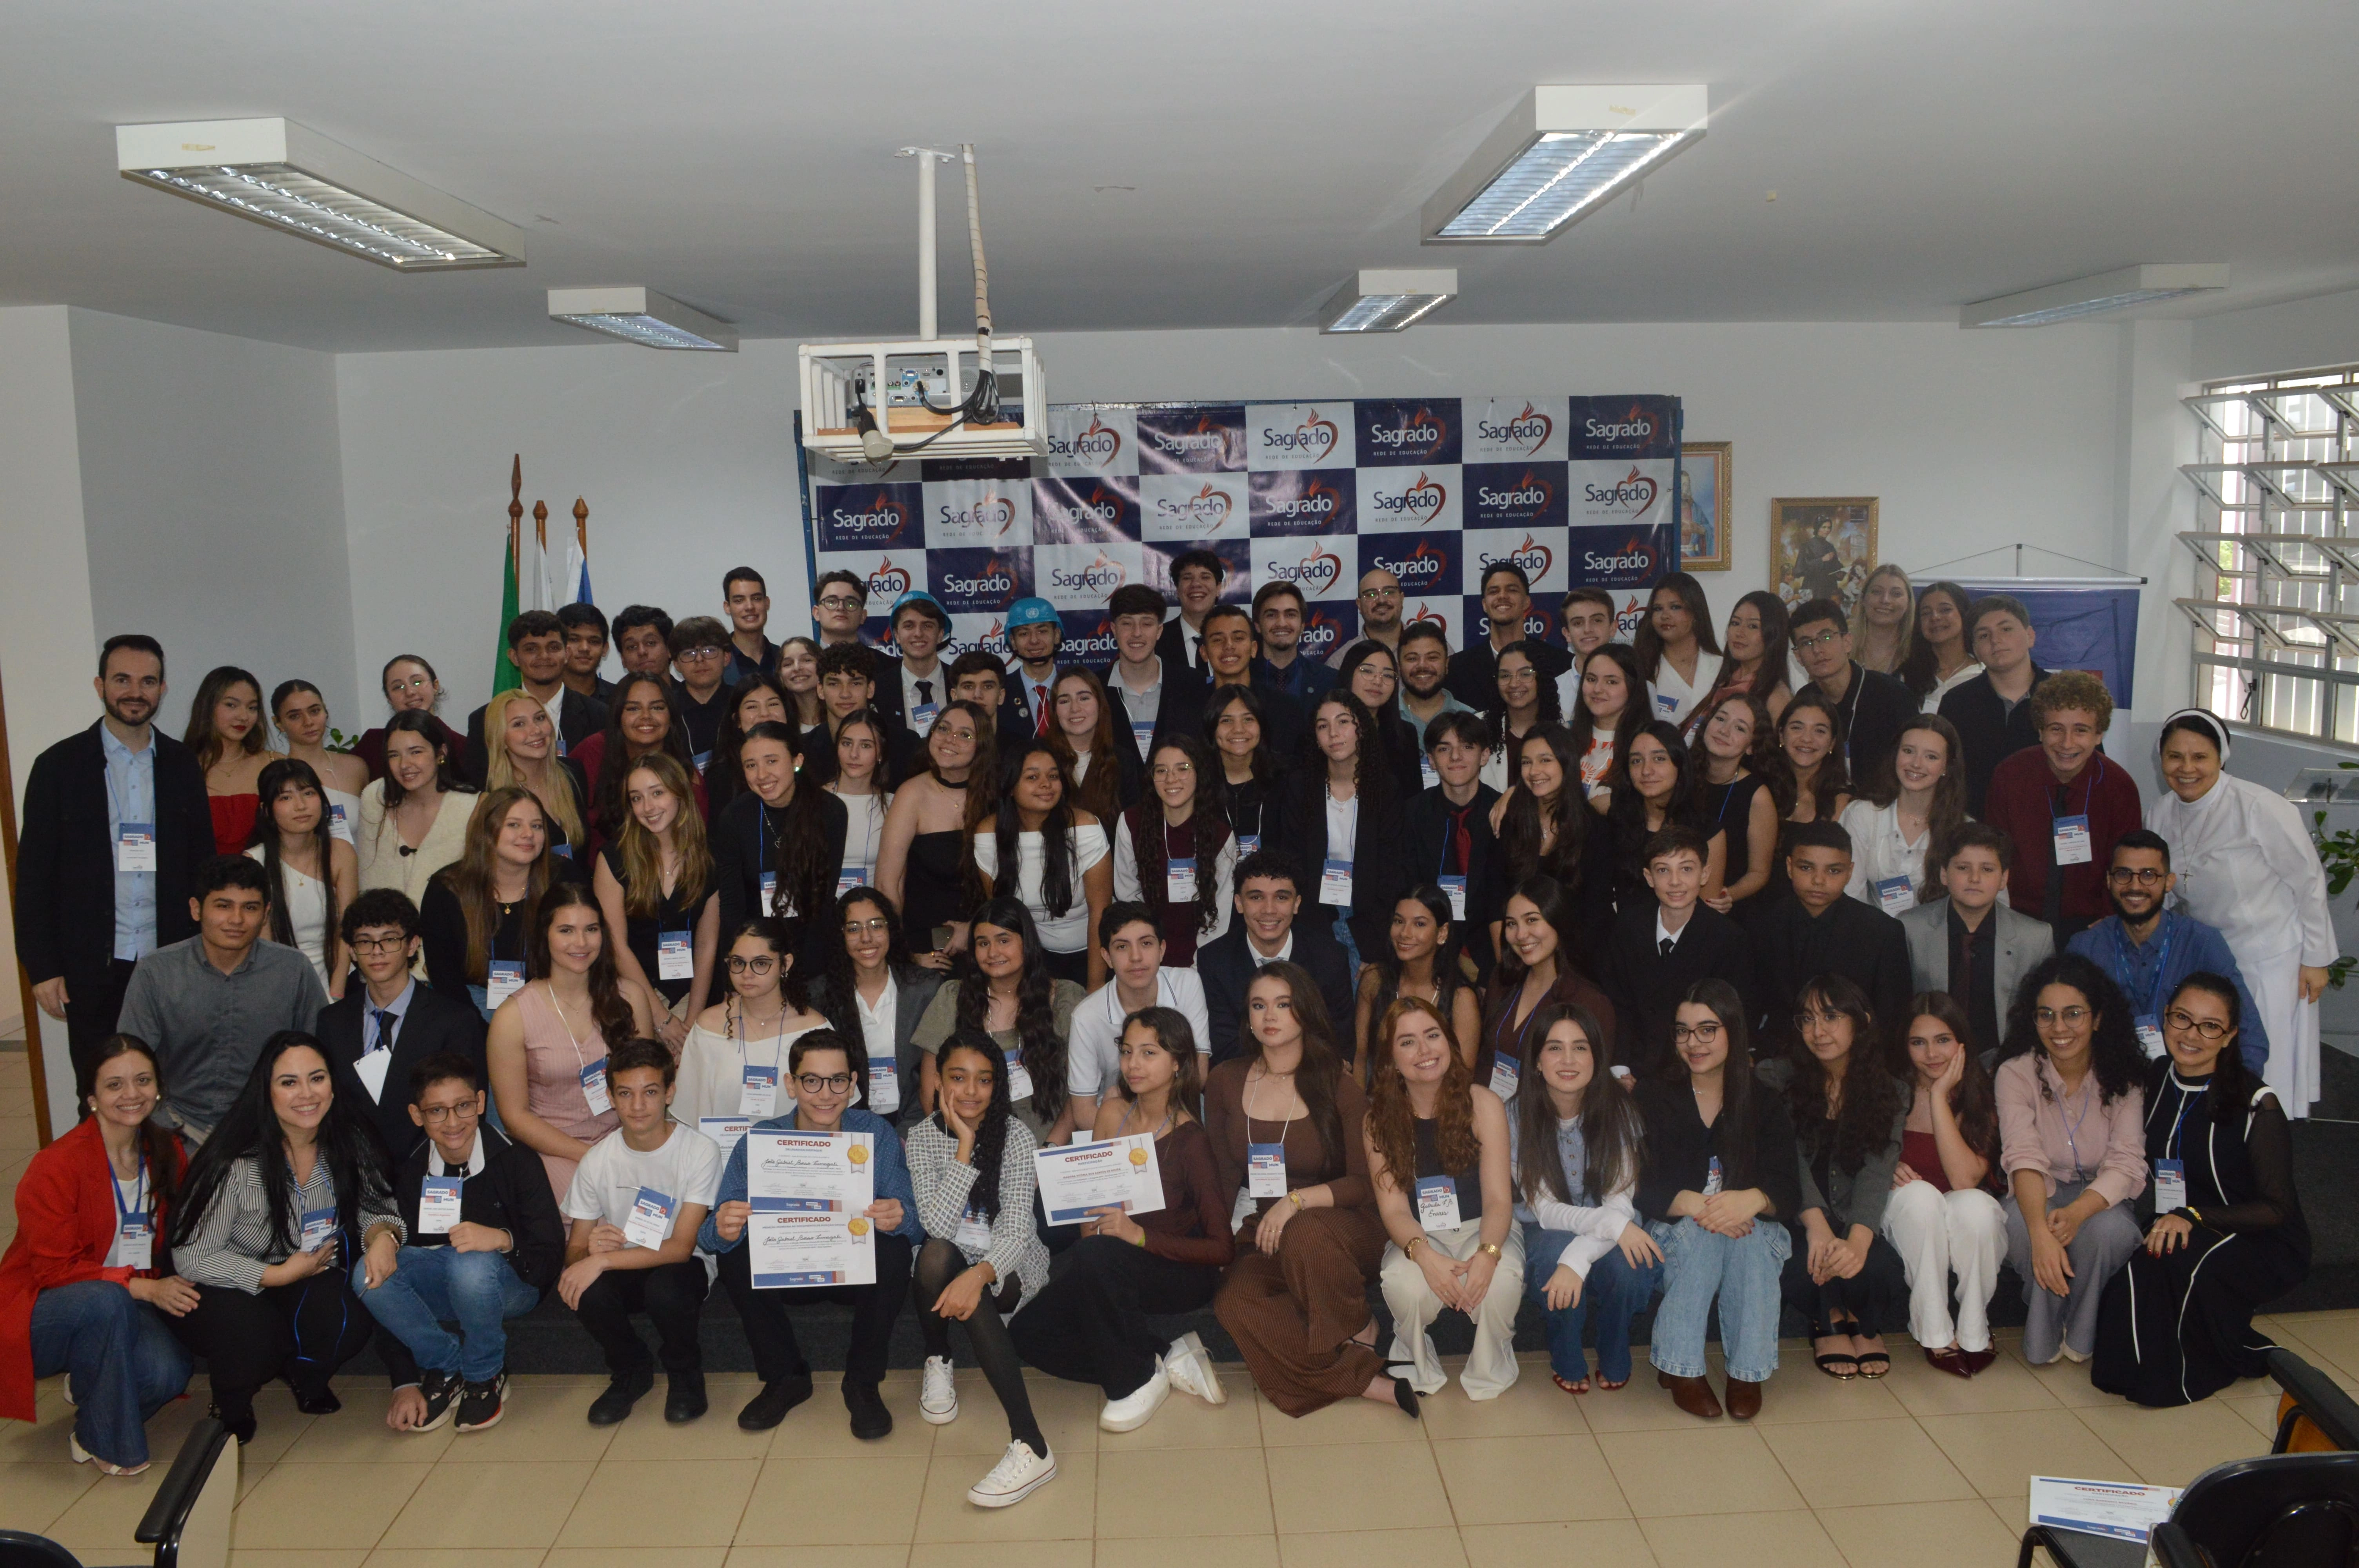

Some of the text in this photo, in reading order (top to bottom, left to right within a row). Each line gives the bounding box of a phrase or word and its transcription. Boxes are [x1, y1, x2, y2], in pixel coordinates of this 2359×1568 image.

[1264, 428, 1330, 450] Sagrado
[1372, 424, 1437, 447] Sagrado
[1479, 421, 1544, 443] Sagrado
[1586, 419, 1650, 441] Sagrado
[1048, 435, 1112, 457] Sagrado
[1155, 432, 1220, 454] Sagrado
[1374, 491, 1438, 513] Sagrado
[1479, 487, 1544, 509] Sagrado
[1585, 484, 1649, 505] Sagrado
[941, 506, 1007, 528] Sagrado
[1157, 498, 1224, 521] Sagrado
[1266, 495, 1332, 517] Sagrado
[833, 509, 899, 532] Sagrado
[1268, 561, 1333, 583] Sagrado
[1374, 556, 1438, 579] Sagrado
[1585, 552, 1648, 573] Sagrado
[861, 575, 902, 593] rado
[944, 574, 1010, 597] Sagrado
[1052, 568, 1118, 590] Sagrado
[1298, 626, 1333, 643] rado
[1065, 1151, 1113, 1162] CERTIFICADO
[640, 1200, 660, 1211] SAGRADO
[2074, 1486, 2145, 1496] CERTIFICADO
